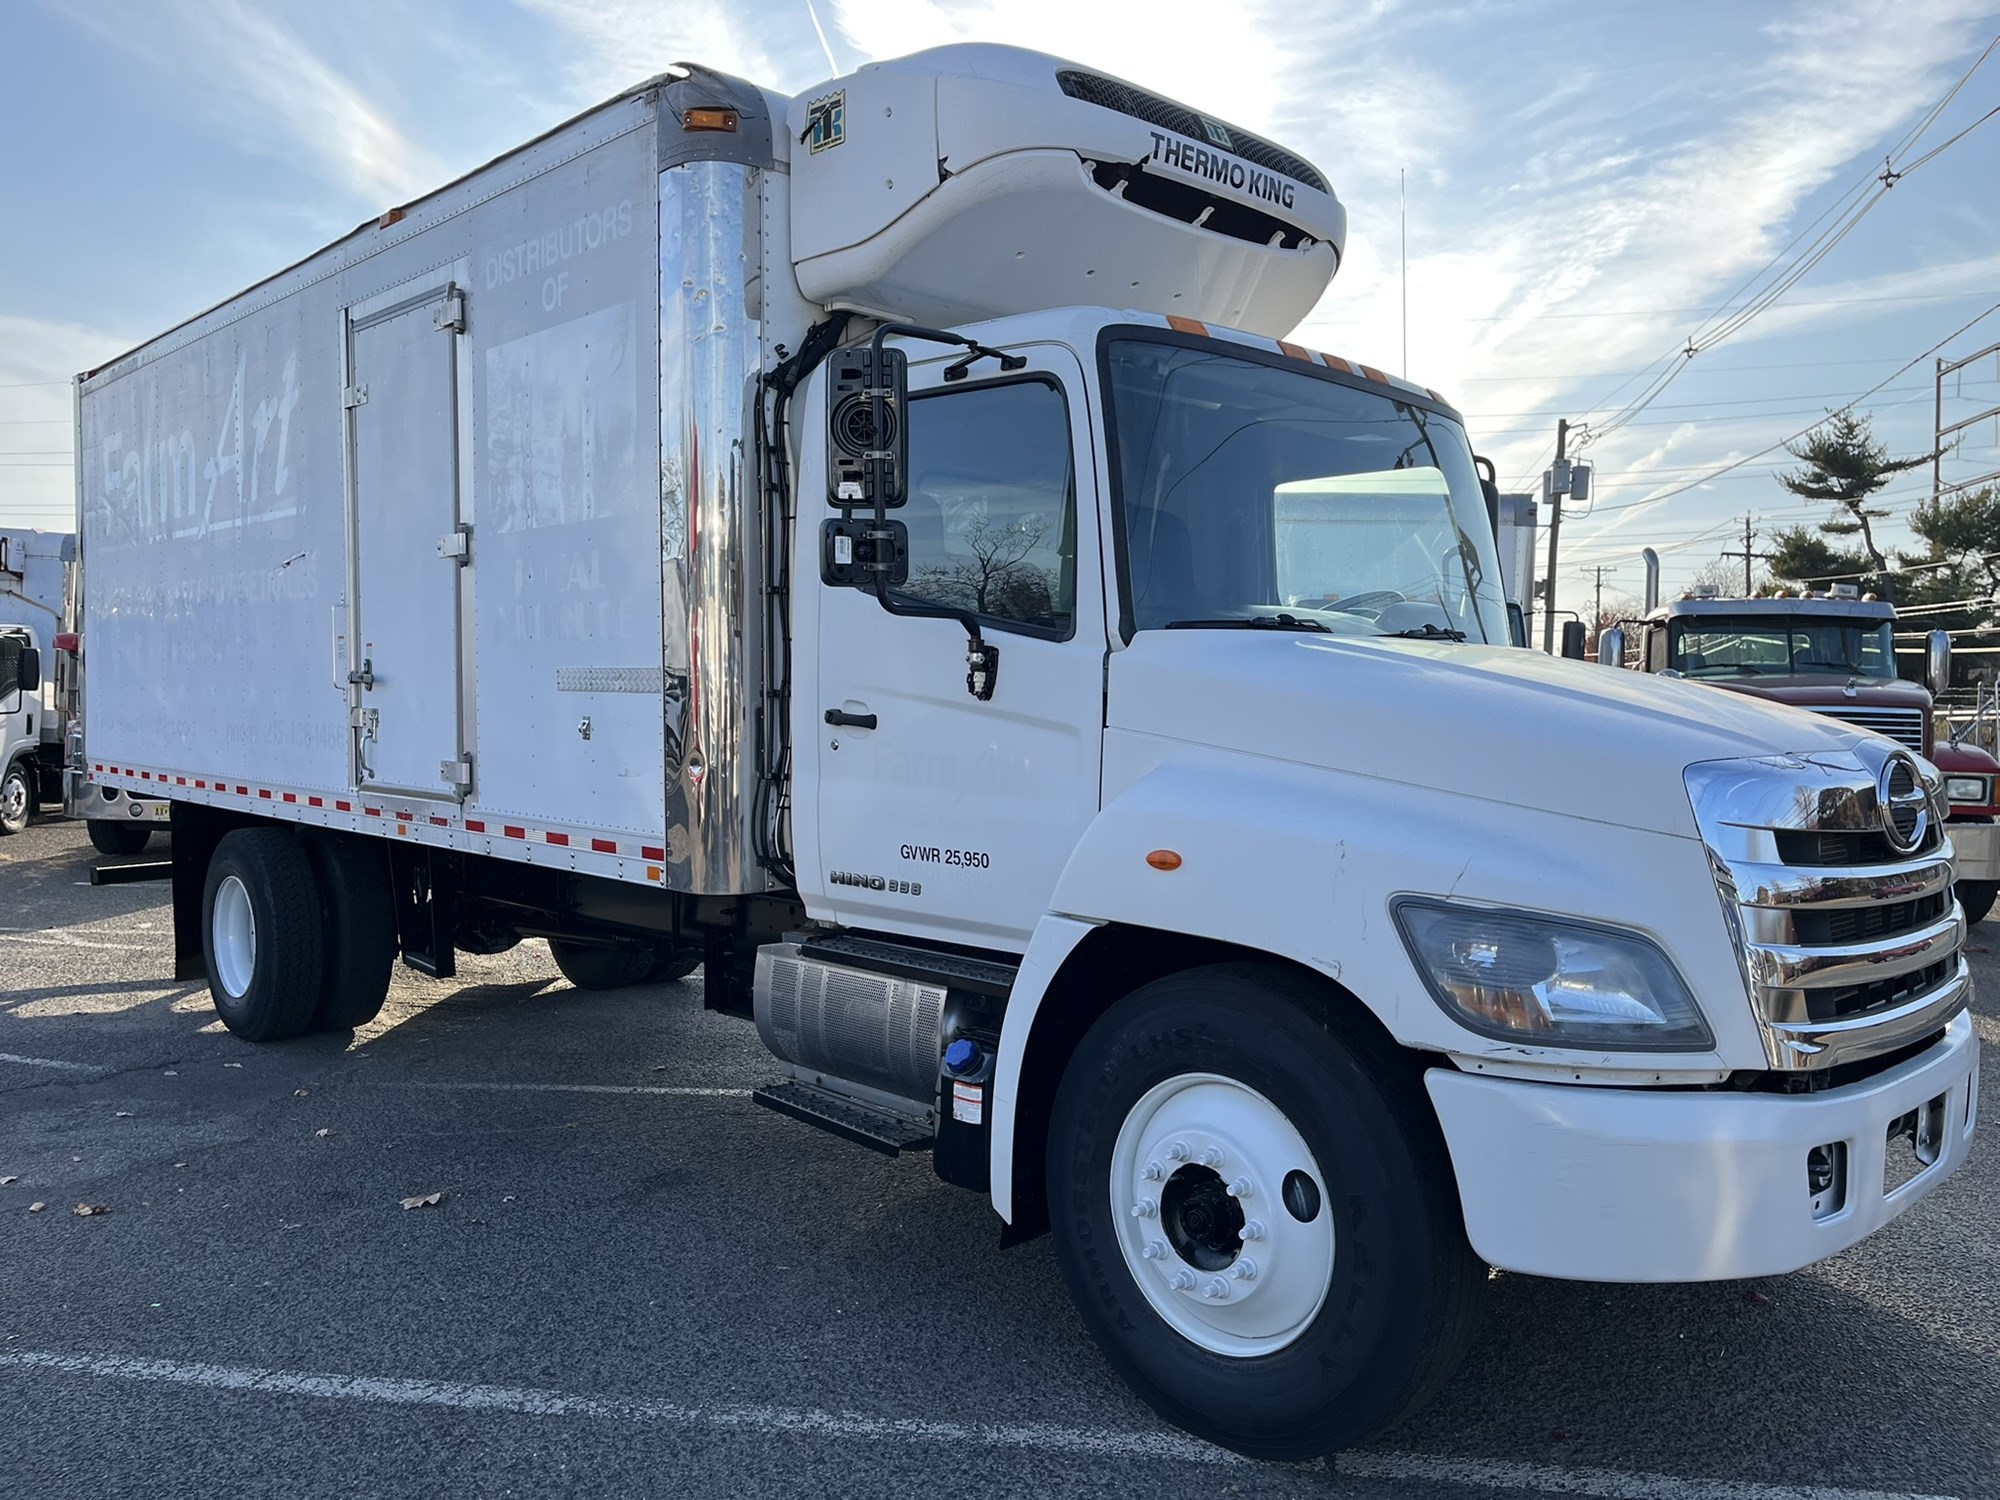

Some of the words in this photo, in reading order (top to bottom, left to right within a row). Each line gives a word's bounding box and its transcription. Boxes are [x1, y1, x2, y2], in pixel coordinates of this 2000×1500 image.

[1150, 131, 1245, 189] THERMO
[1248, 169, 1294, 210] KING
[486, 199, 632, 291] DISTRIBUTORS
[541, 271, 568, 311] OF
[900, 844, 941, 863] GVWR
[945, 849, 990, 868] 25,950
[830, 871, 885, 891] HINO
[889, 879, 922, 896] 338
